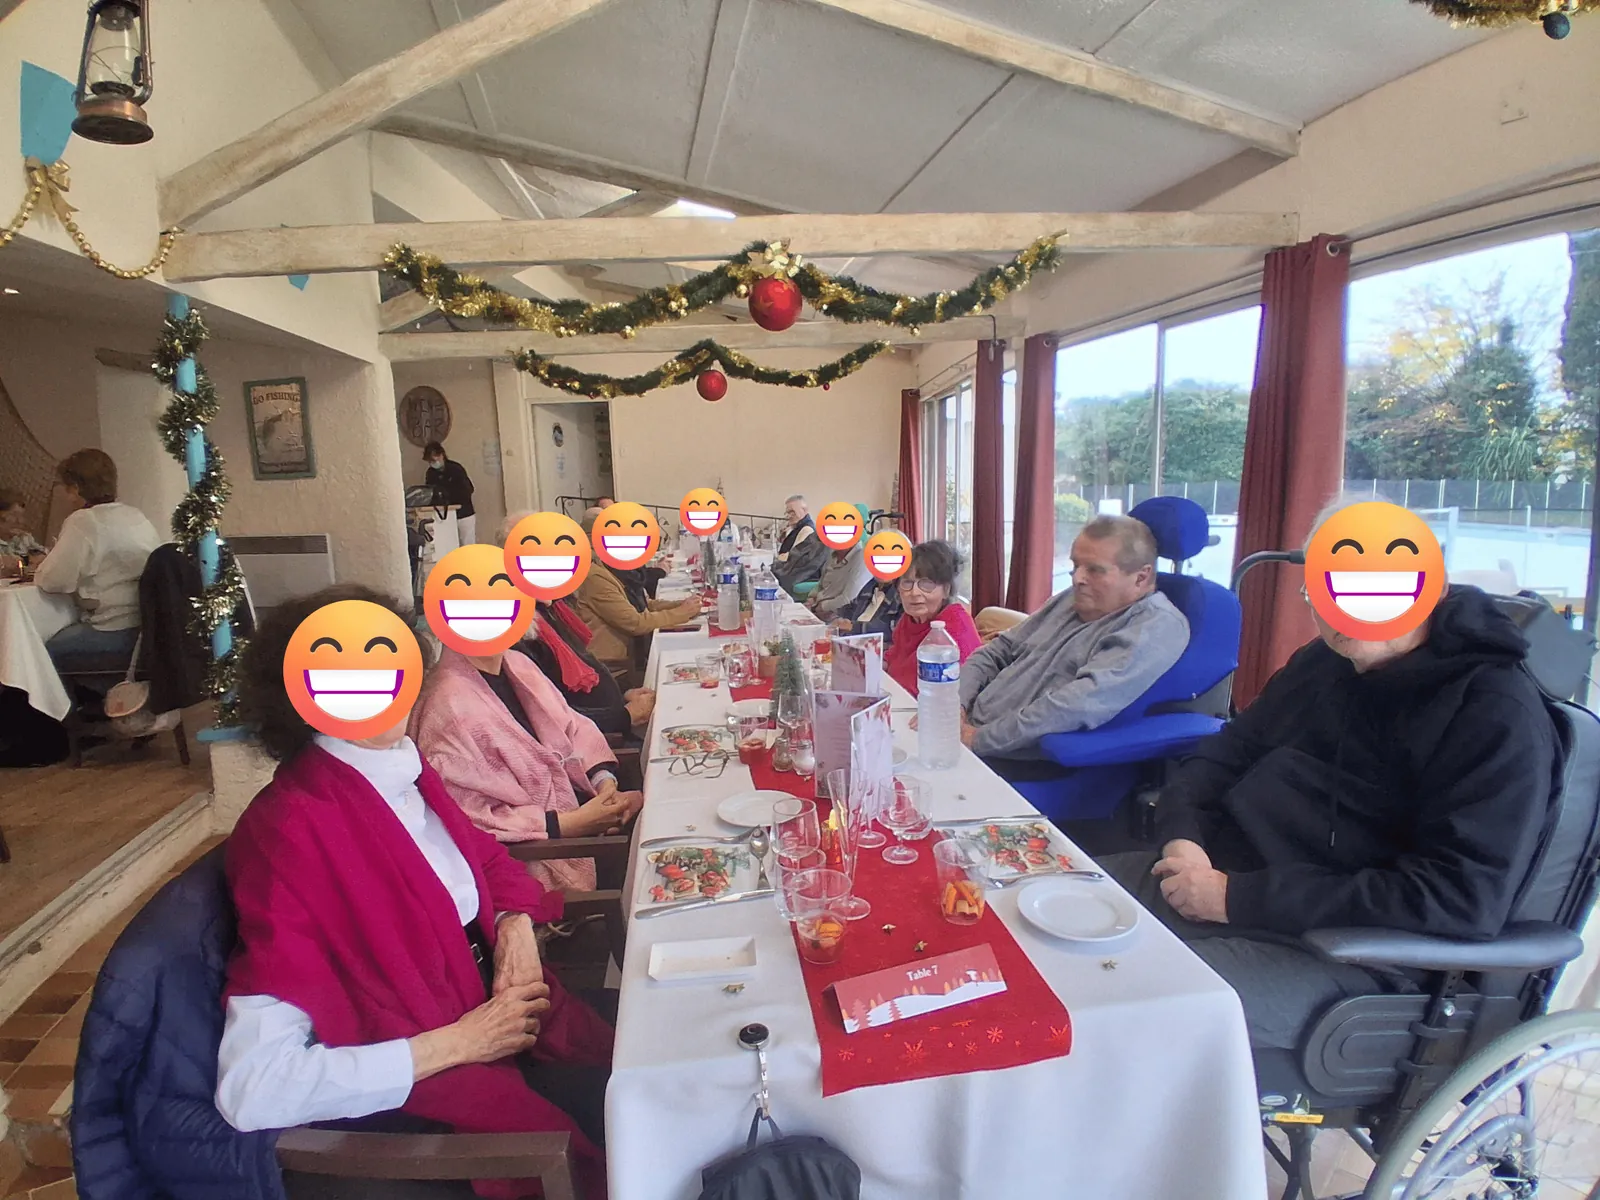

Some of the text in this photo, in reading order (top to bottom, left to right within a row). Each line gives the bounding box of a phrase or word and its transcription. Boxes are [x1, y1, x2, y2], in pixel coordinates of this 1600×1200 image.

[265, 391, 299, 402] FISHING
[408, 397, 445, 419] WINE
[410, 417, 445, 438] BAR
[906, 964, 938, 981] Table 7
